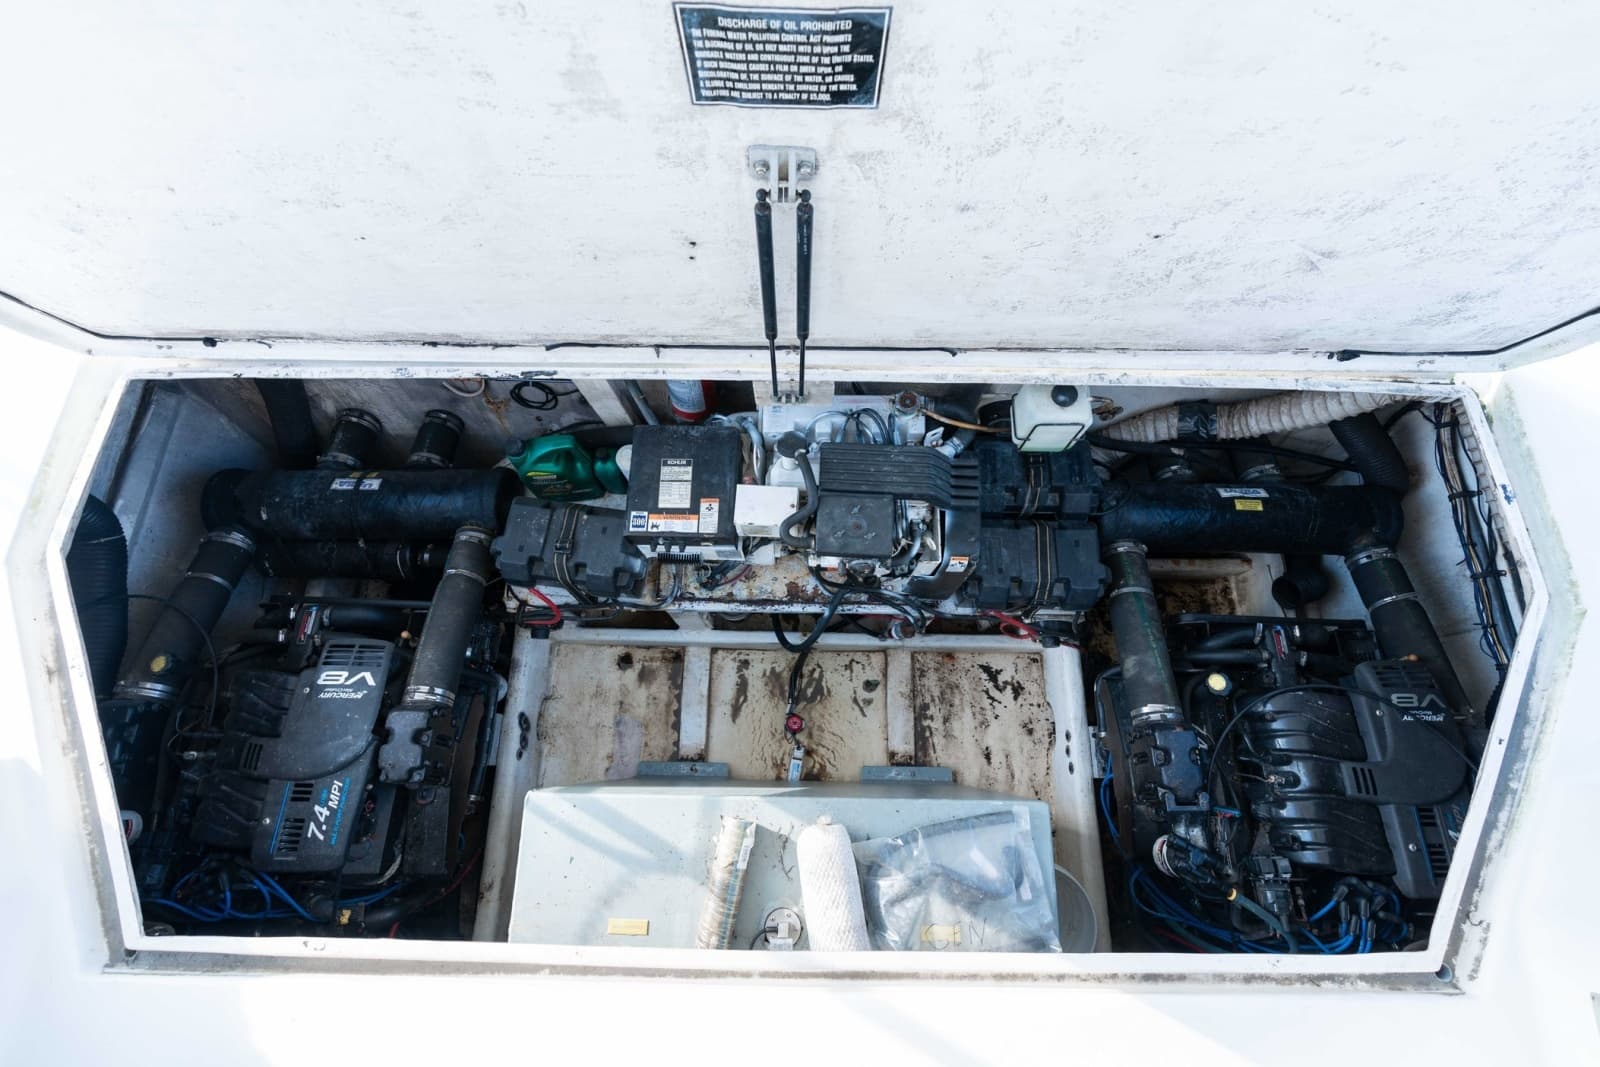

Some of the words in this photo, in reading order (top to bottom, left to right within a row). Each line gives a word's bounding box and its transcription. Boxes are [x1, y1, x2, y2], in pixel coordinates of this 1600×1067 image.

[717, 16, 768, 29] DISCHARGE
[769, 19, 781, 30] OF
[783, 19, 798, 31] OIL
[800, 19, 852, 31] PROHIBITED
[703, 28, 726, 38] FEDERAL
[726, 30, 747, 40] WATER
[748, 32, 780, 41] POLLUTION
[781, 33, 807, 42] CONTROL
[809, 34, 821, 43] ACT
[316, 670, 376, 686] V8
[319, 690, 368, 699] MERCURY
[1391, 693, 1447, 708] V8
[327, 779, 344, 809] MPI
[306, 803, 331, 841] 7.4
